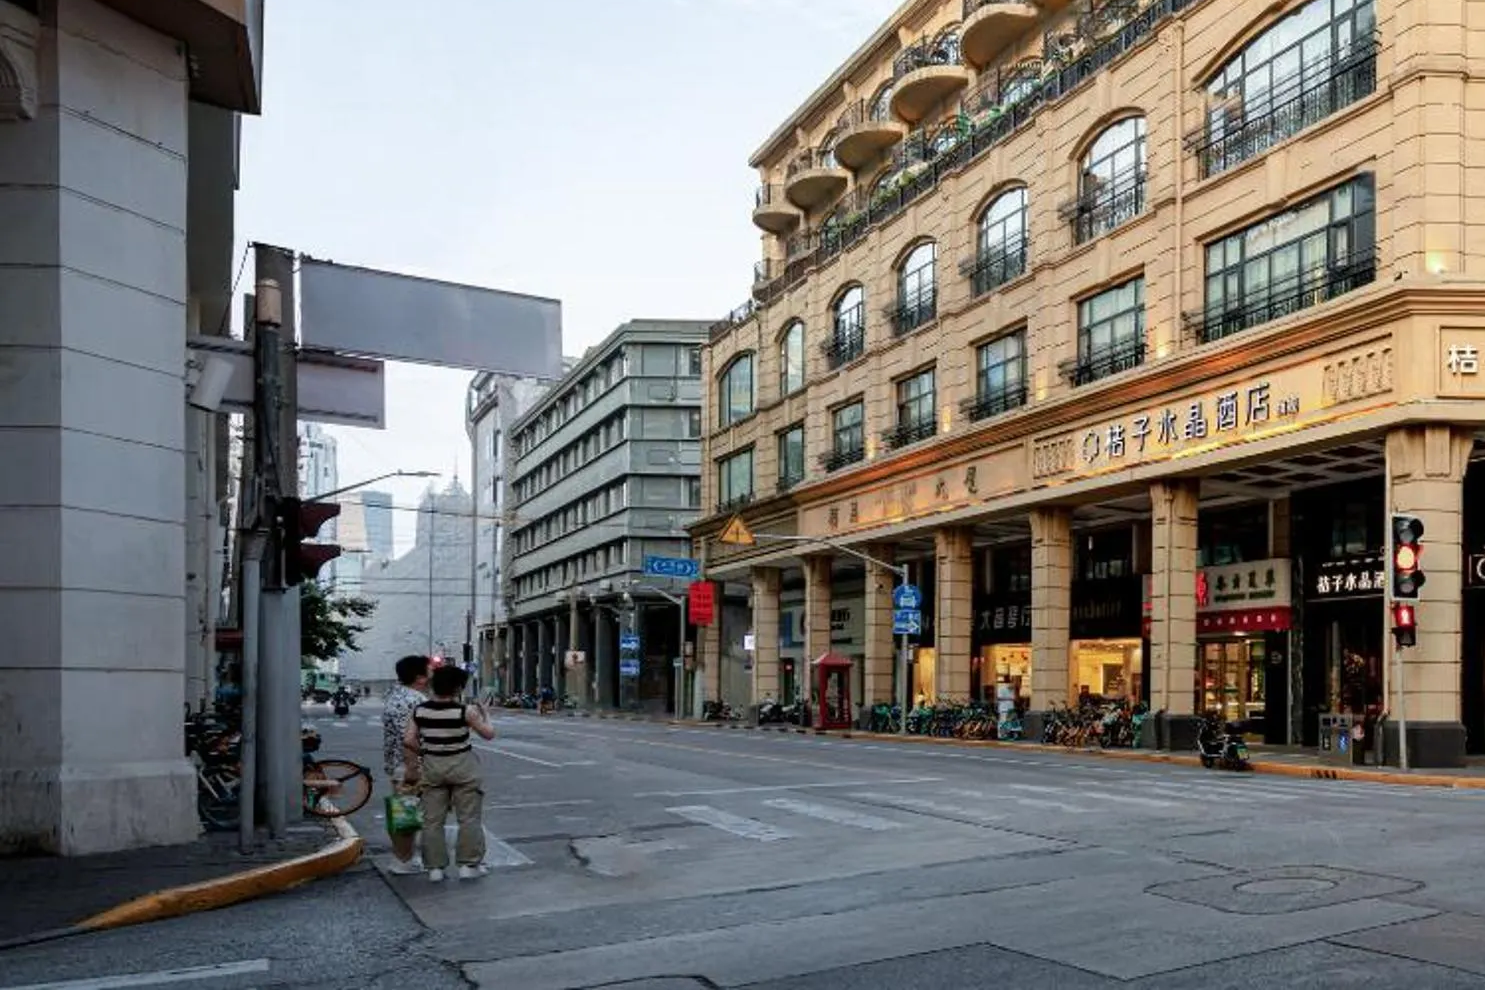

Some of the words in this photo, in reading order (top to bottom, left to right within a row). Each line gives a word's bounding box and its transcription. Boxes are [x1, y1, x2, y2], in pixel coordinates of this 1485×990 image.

[1106, 381, 1271, 458] 桔子水晶酒店
